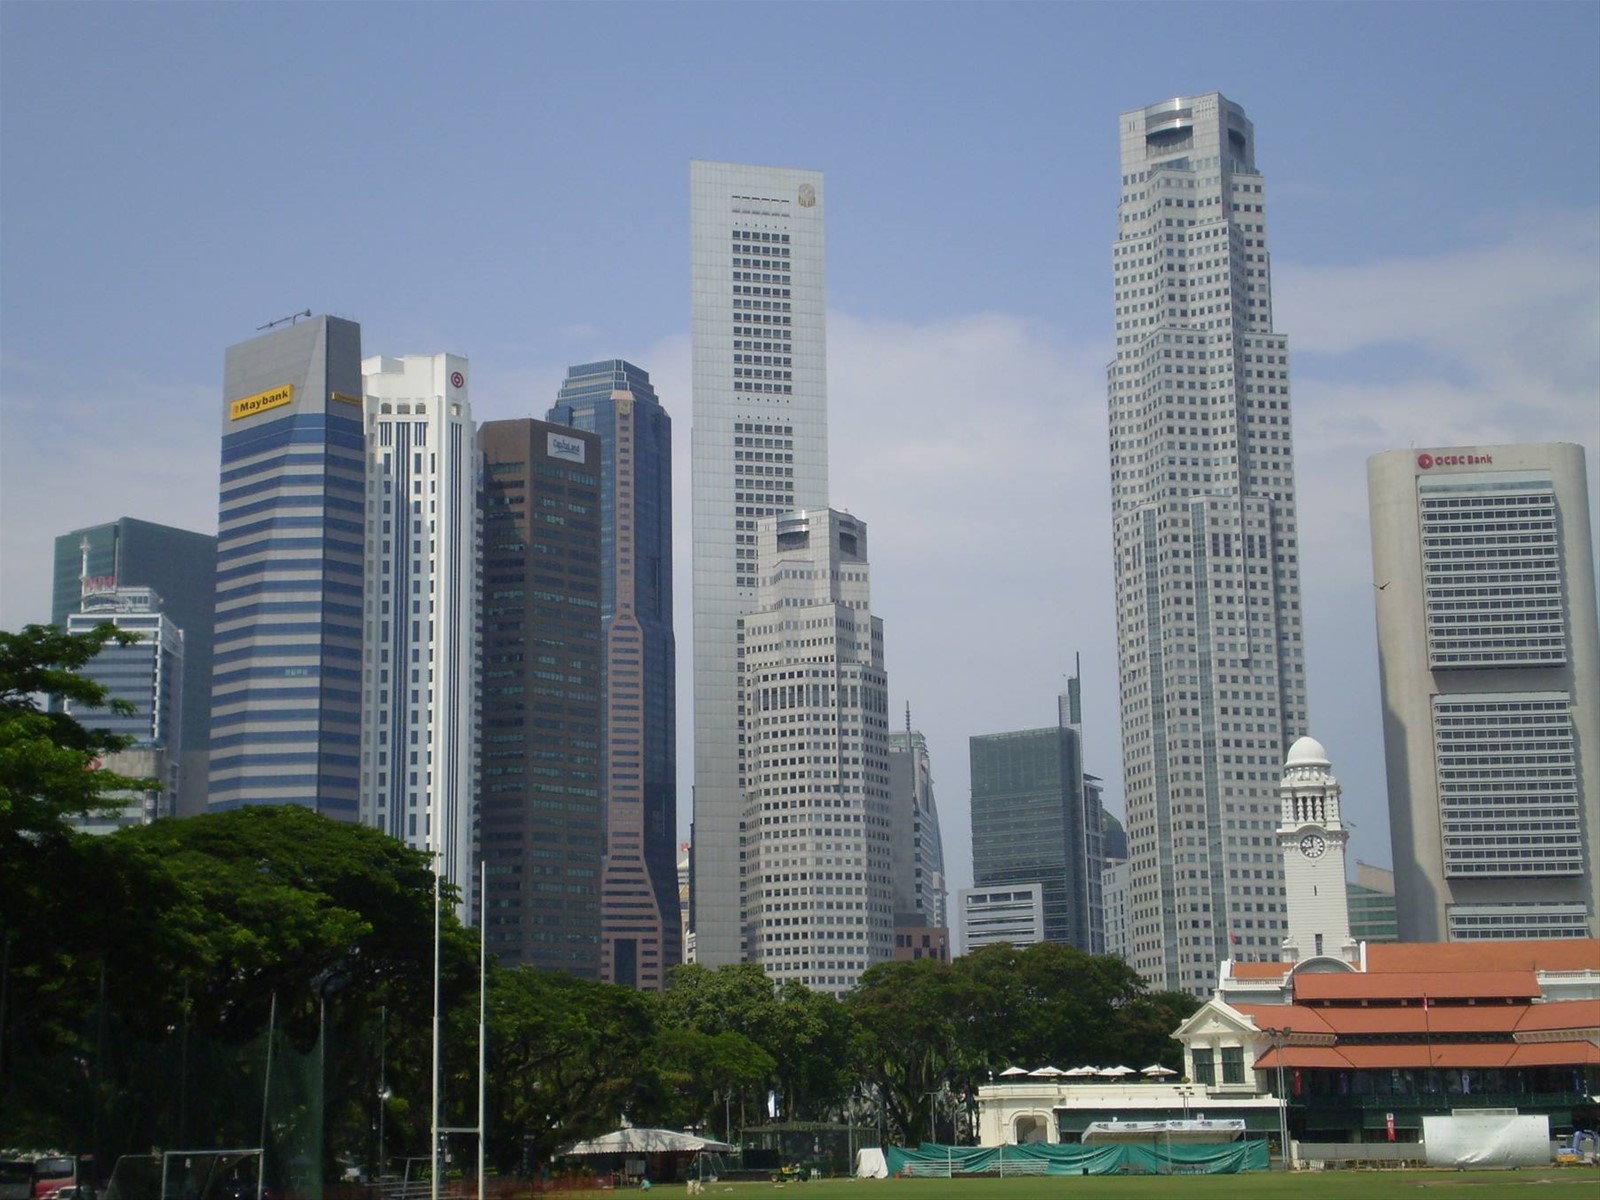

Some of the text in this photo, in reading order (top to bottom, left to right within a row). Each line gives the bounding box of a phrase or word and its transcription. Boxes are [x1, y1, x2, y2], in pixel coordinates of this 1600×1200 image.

[239, 390, 289, 413] Maybank
[1435, 454, 1493, 466] OCBC Bank
